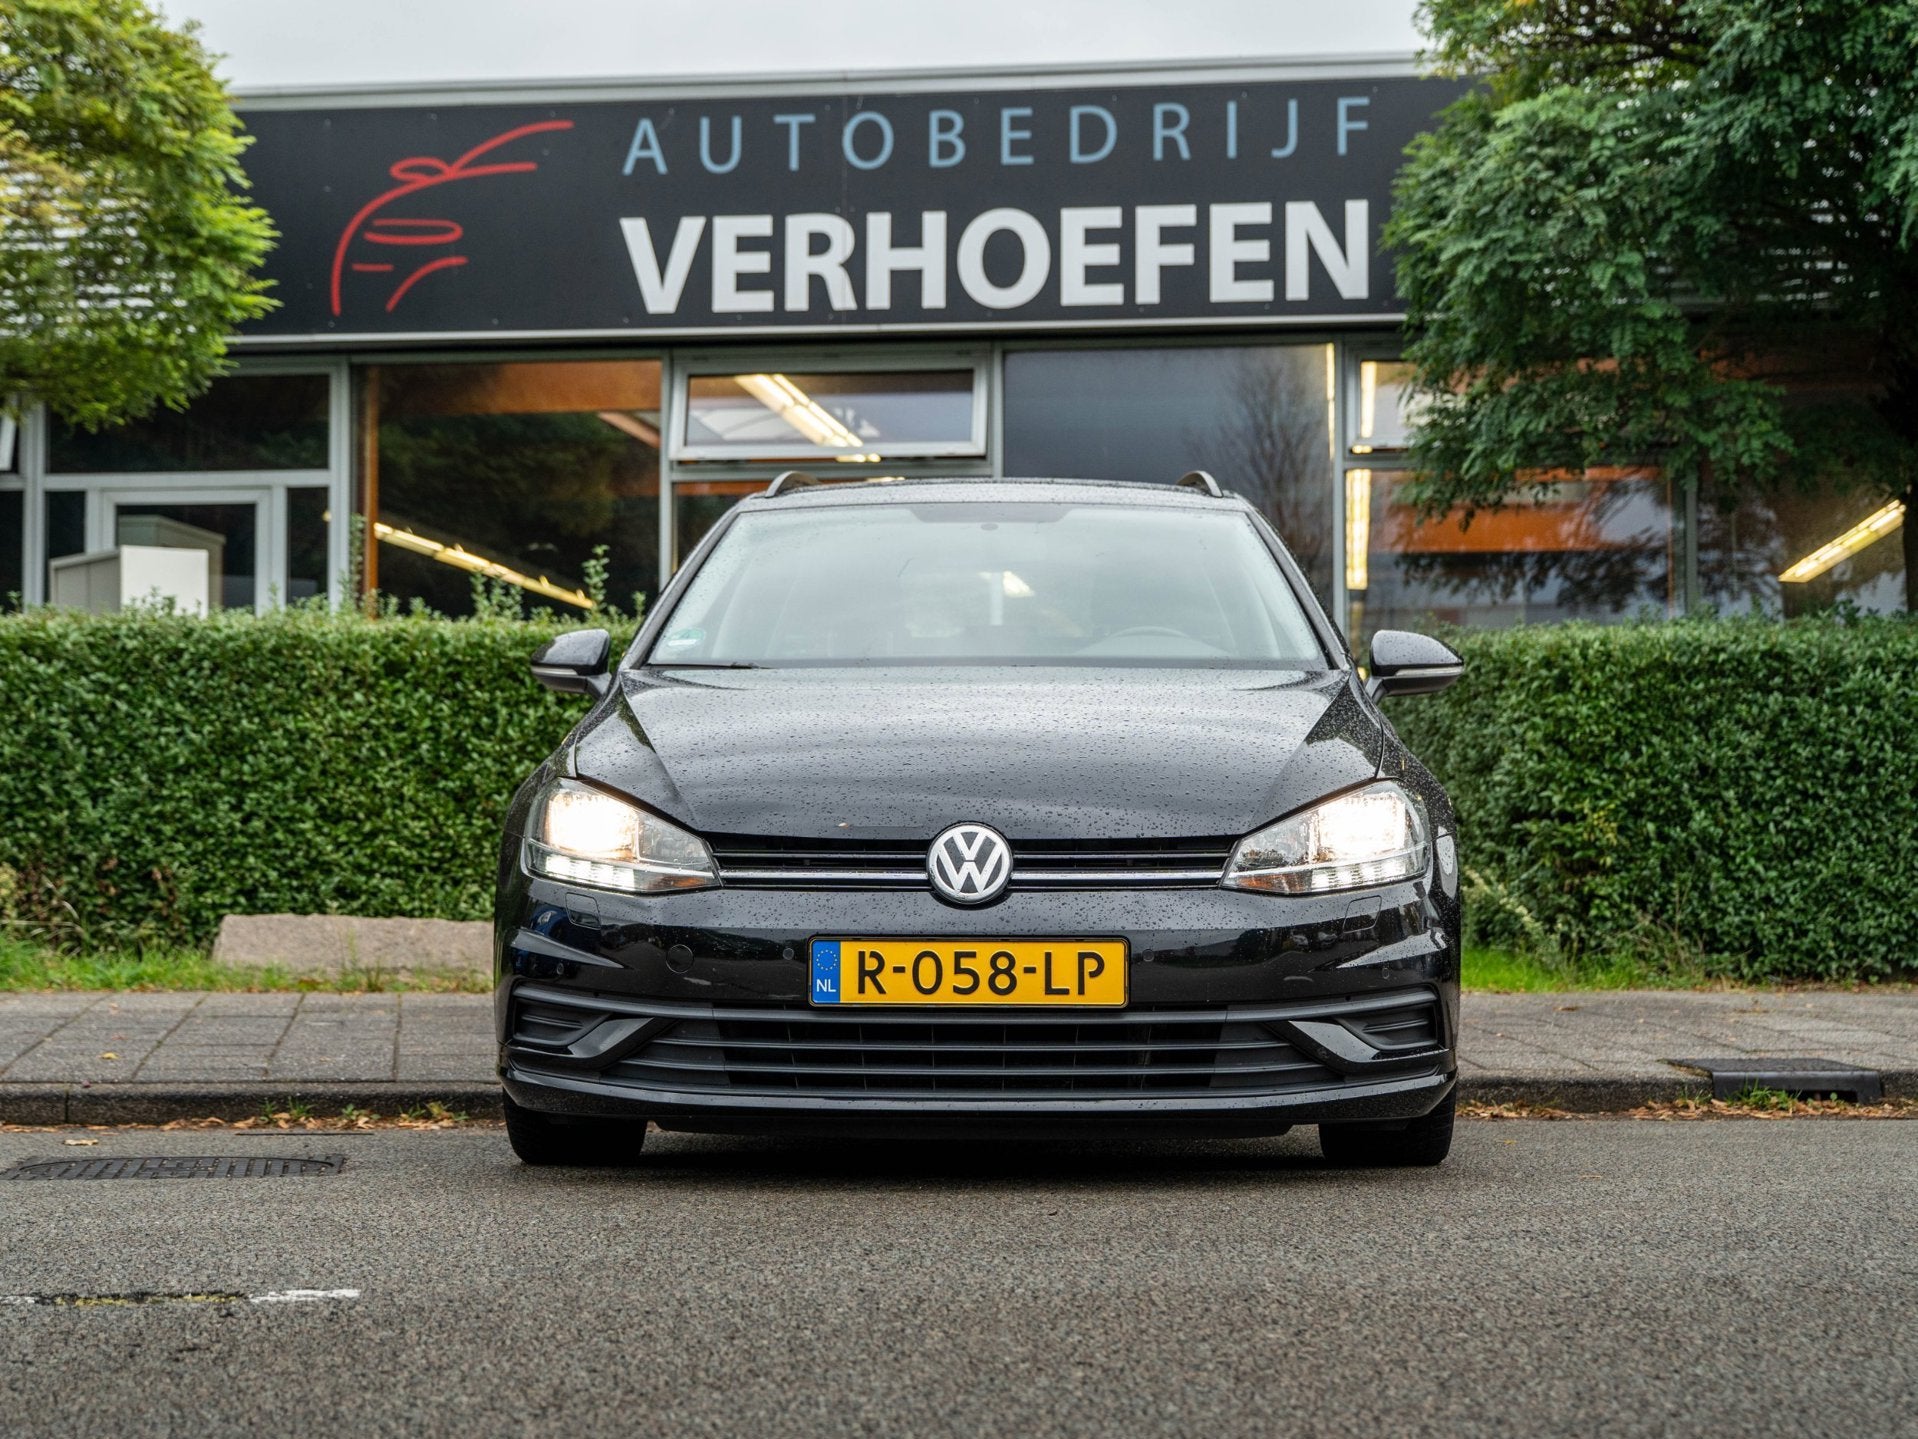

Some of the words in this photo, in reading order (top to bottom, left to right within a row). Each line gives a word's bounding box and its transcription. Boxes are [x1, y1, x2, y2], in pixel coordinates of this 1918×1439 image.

[622, 97, 1371, 175] AUTOBEDRIJF
[620, 199, 1370, 315] VERHOEFEN
[934, 827, 1005, 898] VW
[816, 979, 837, 993] NL
[857, 950, 1105, 996] R-058-LP
